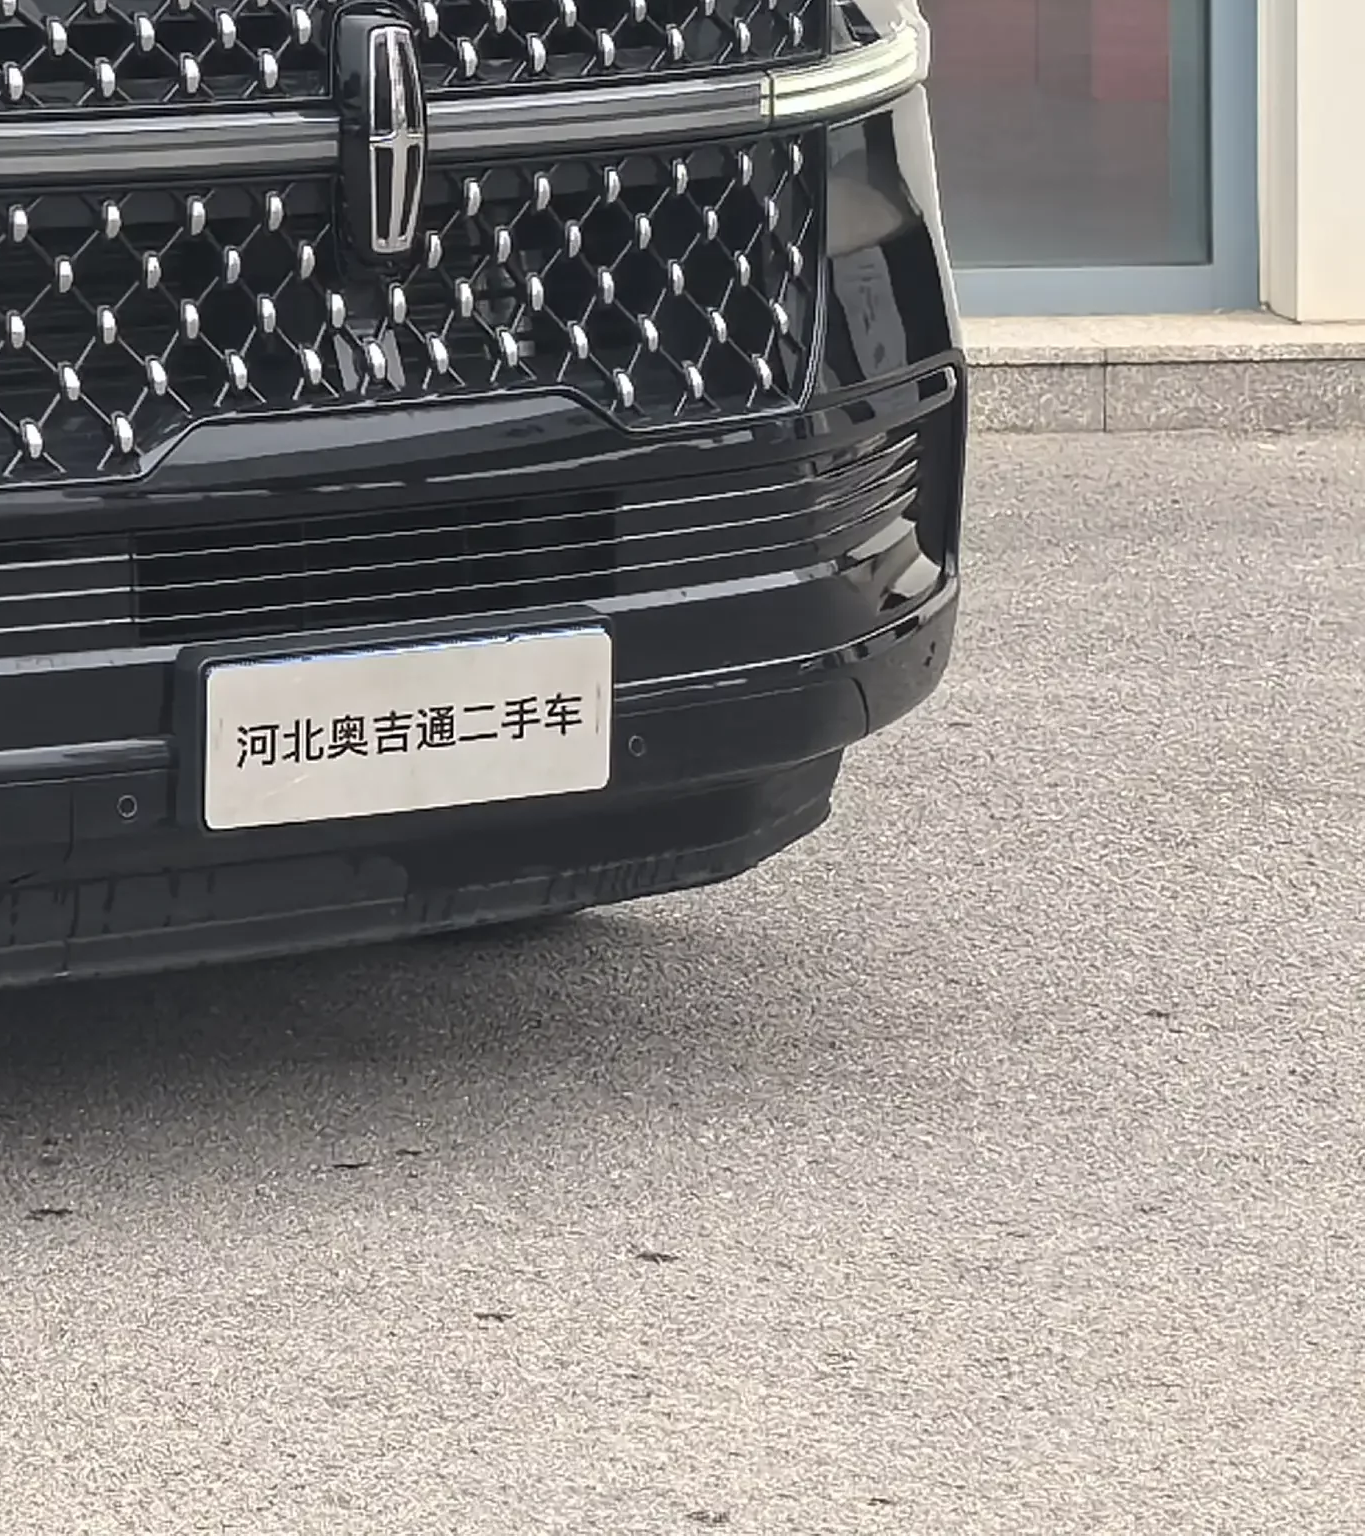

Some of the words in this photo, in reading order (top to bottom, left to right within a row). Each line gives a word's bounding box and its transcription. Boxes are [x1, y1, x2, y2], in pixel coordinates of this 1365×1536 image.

[236, 693, 583, 768] 河北奥吉通二手车
